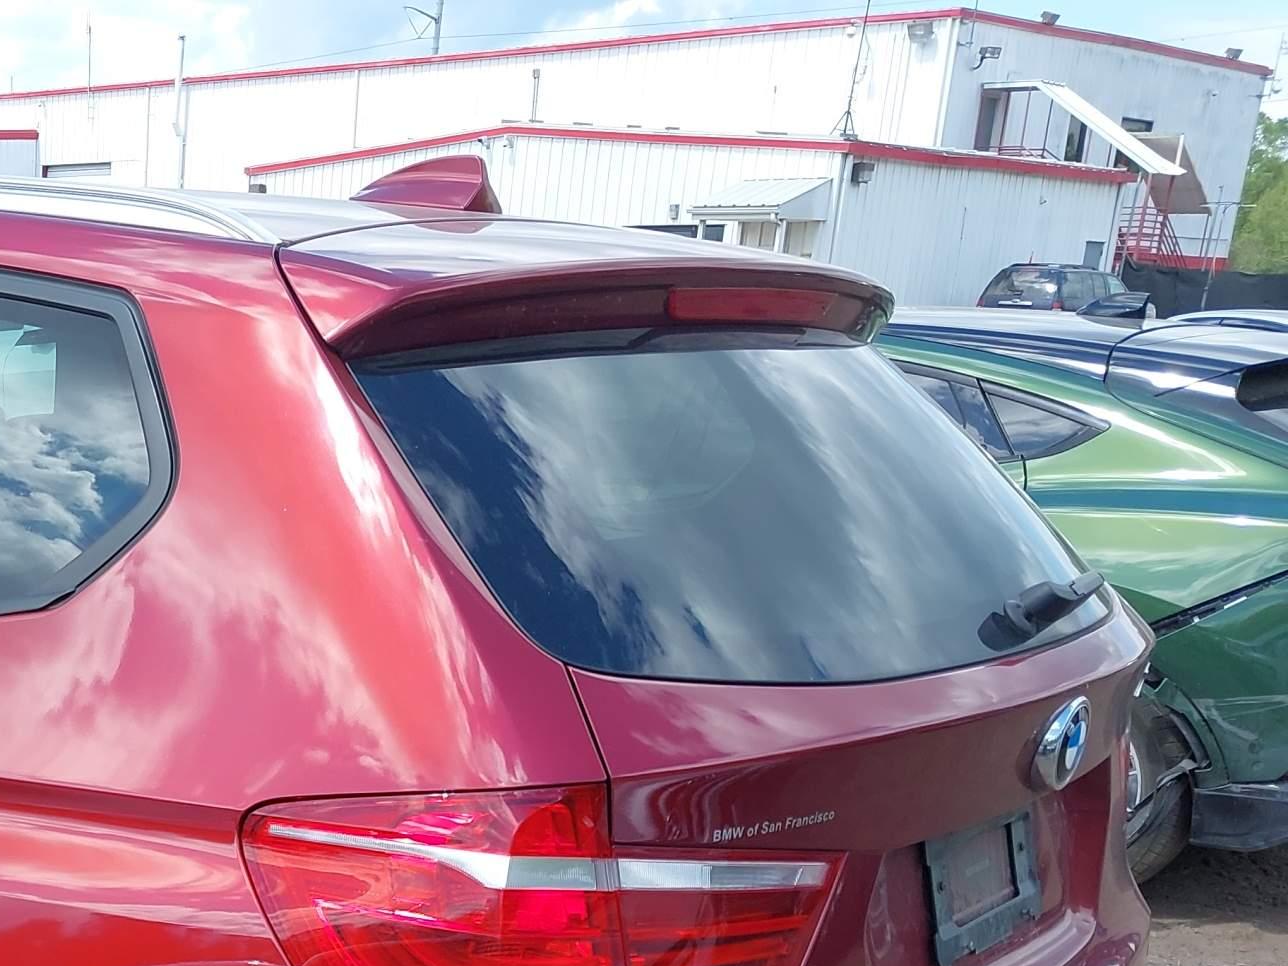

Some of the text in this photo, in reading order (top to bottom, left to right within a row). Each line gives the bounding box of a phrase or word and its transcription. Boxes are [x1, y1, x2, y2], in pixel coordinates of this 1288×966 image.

[712, 810, 835, 843] BMW of San Francisco
